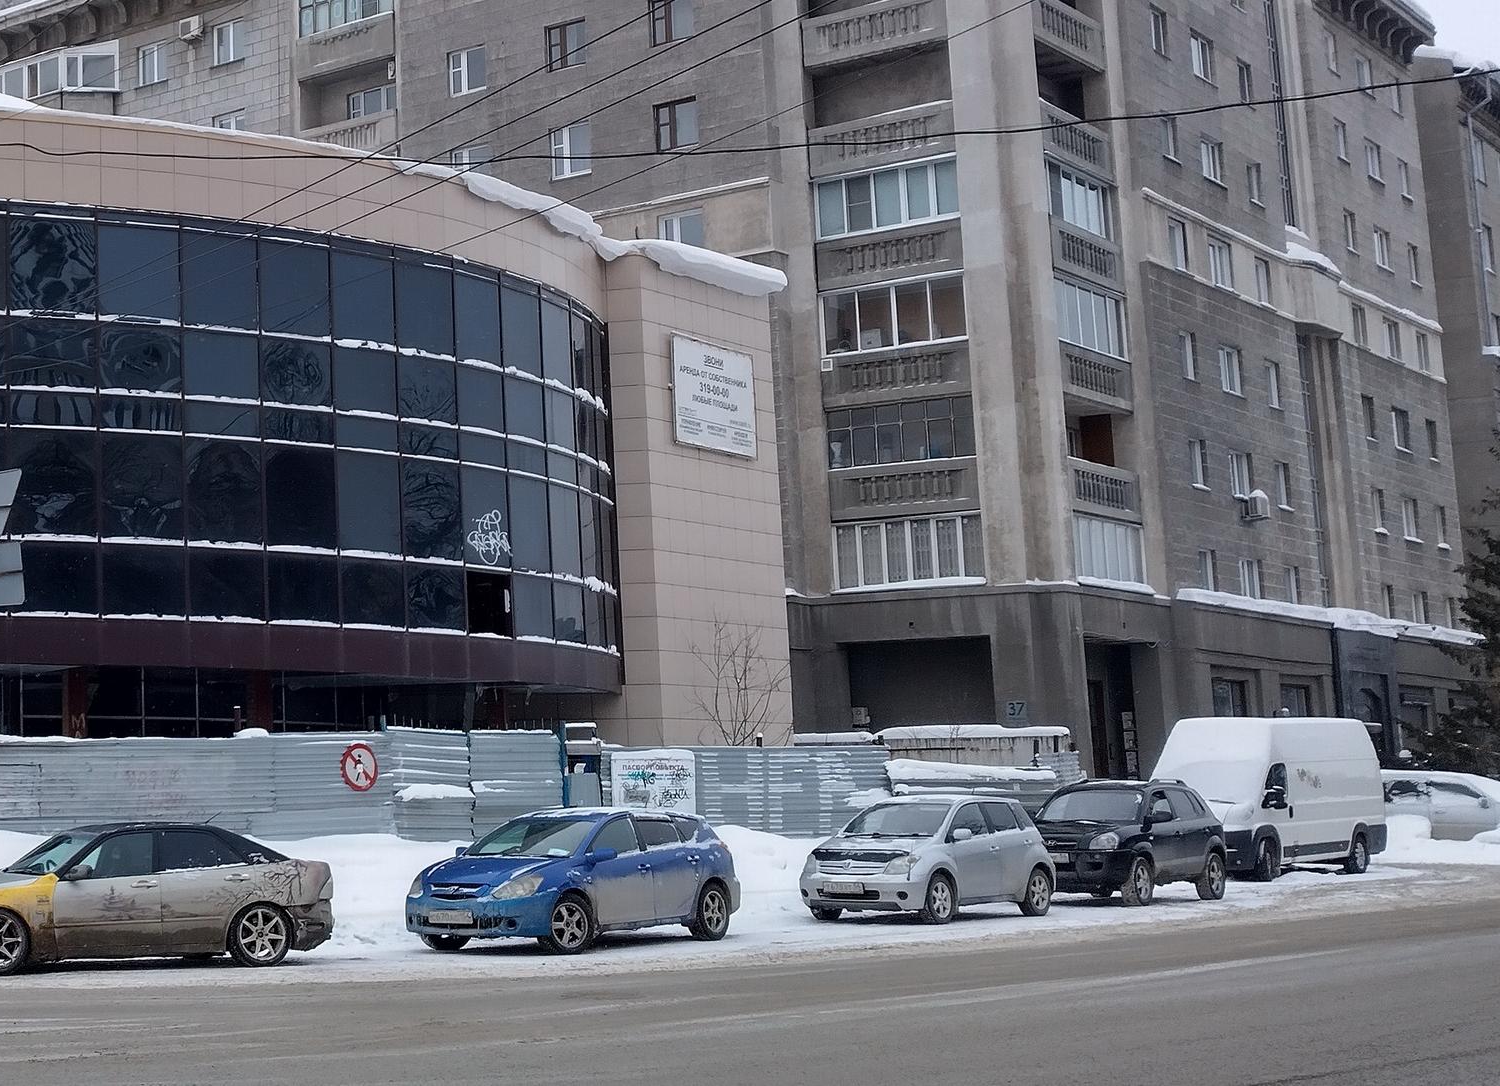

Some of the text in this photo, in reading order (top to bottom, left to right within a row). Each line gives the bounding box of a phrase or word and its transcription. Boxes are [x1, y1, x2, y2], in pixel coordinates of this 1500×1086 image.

[703, 355, 724, 368] ЗВОНИ
[679, 365, 748, 389] АРЕНДА ОТ СОБСТВЕННИКА
[699, 382, 730, 398] 319-00-00
[1008, 702, 1025, 716] 37
